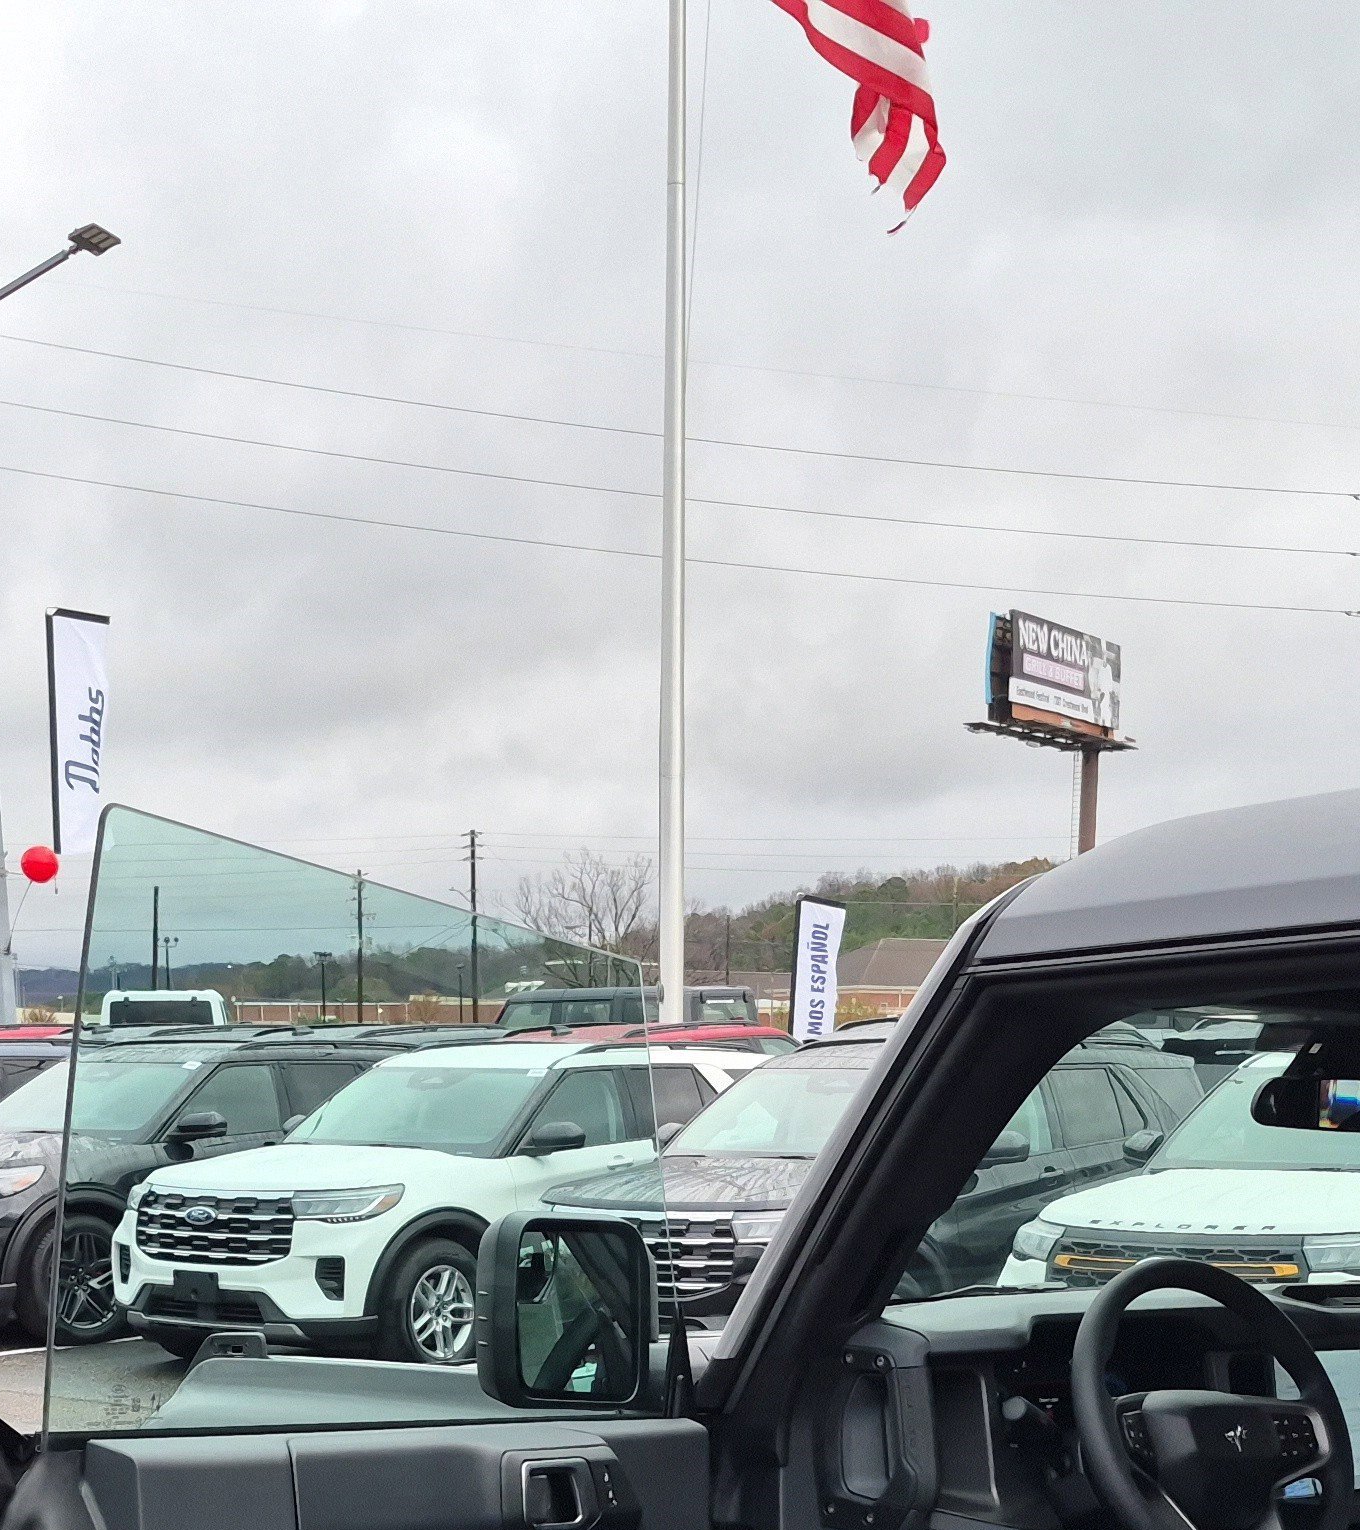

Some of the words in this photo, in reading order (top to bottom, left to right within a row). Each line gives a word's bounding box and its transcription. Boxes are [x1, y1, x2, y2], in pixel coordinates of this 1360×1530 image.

[1018, 618, 1049, 656] NEW
[1050, 629, 1089, 667] CHINA
[806, 923, 830, 994] ESPAÑOL
[1089, 1218, 1276, 1231] EXPLORER
